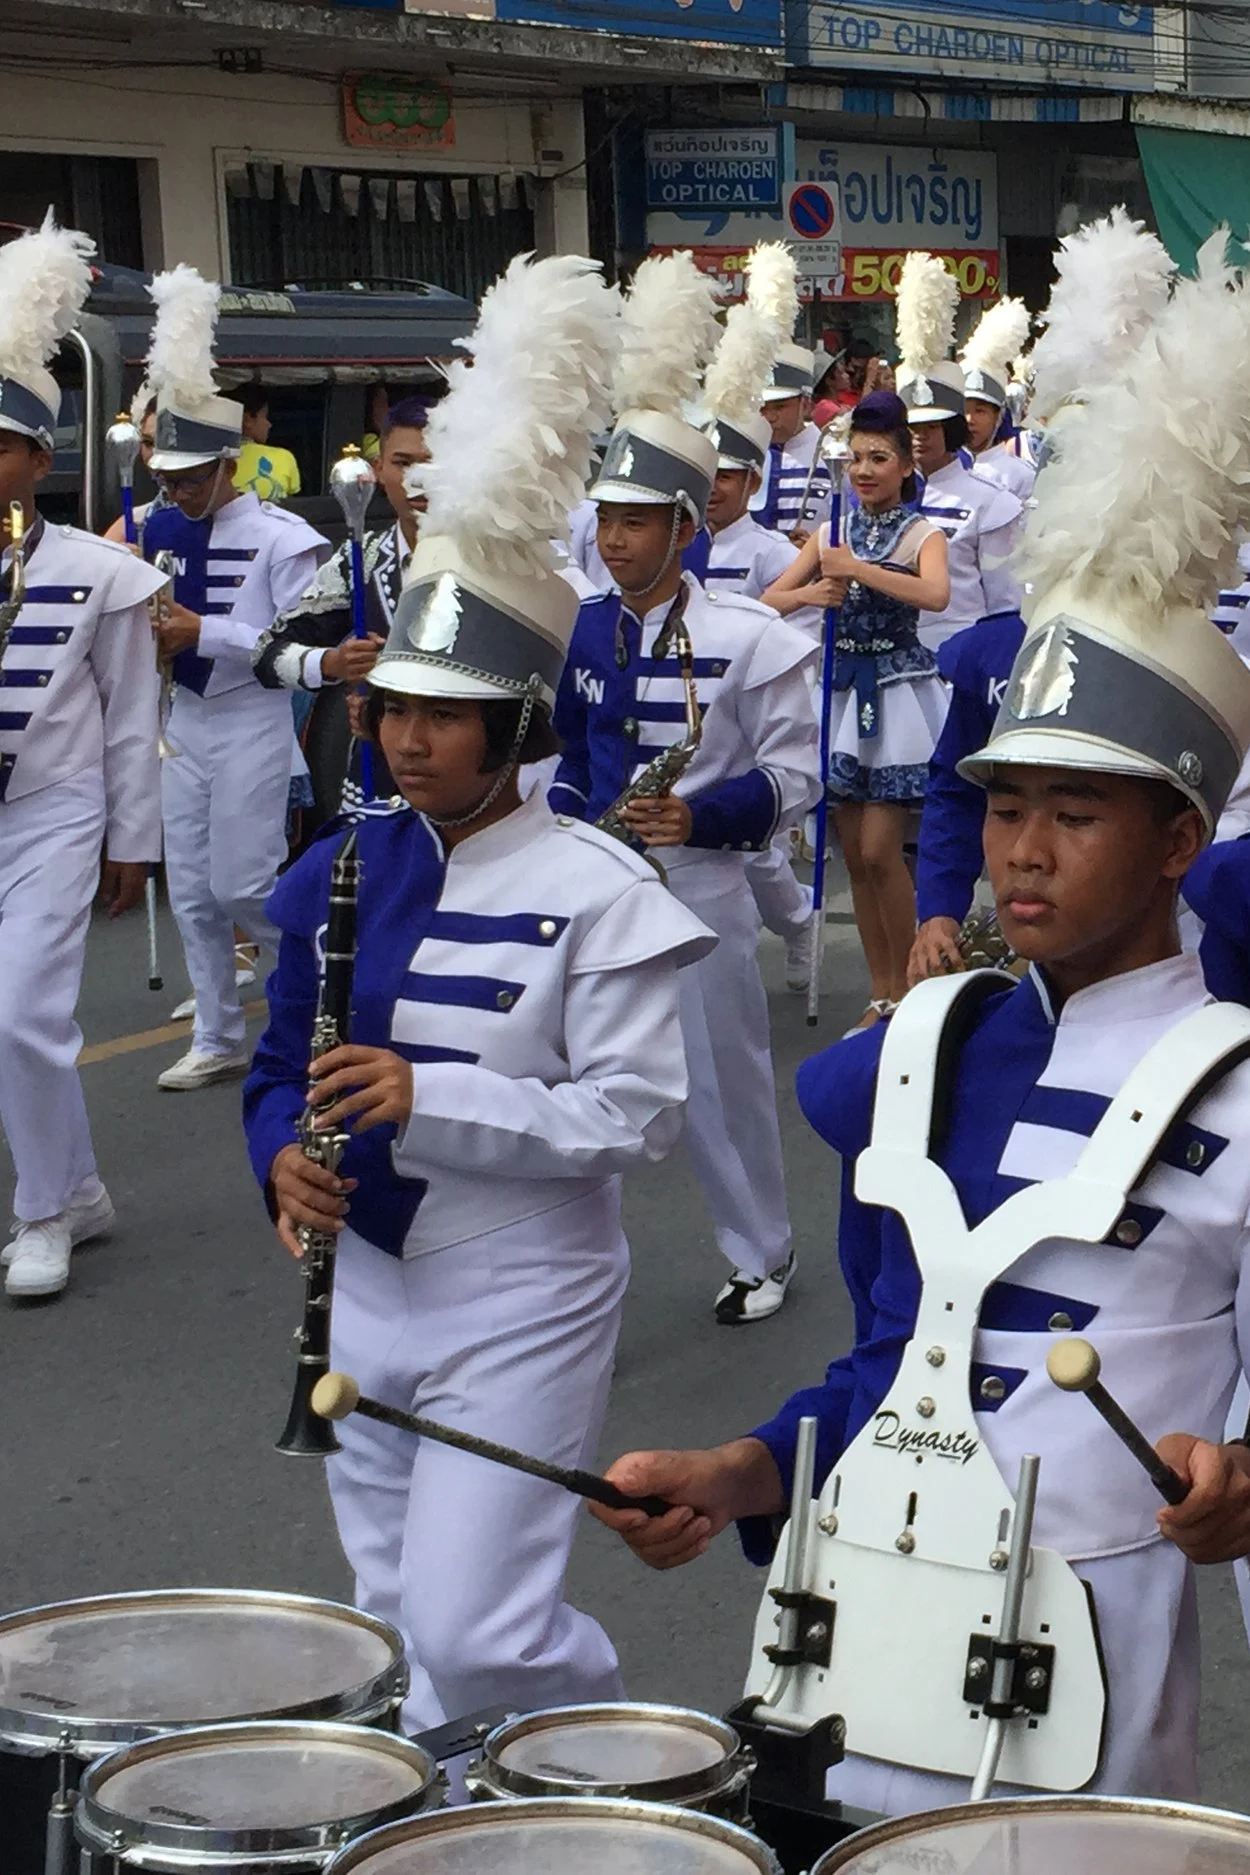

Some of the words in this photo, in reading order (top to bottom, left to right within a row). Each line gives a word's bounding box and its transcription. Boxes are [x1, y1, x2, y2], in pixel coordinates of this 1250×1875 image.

[822, 15, 881, 50] TOP
[894, 23, 1024, 65] CHAROEN
[1036, 38, 1136, 74] OPTICAL
[650, 161, 683, 180] TOP
[693, 161, 773, 180] CHAROEN
[661, 184, 761, 202] OPTICAL
[575, 667, 606, 705] KN
[874, 1410, 980, 1466] Dynasty
